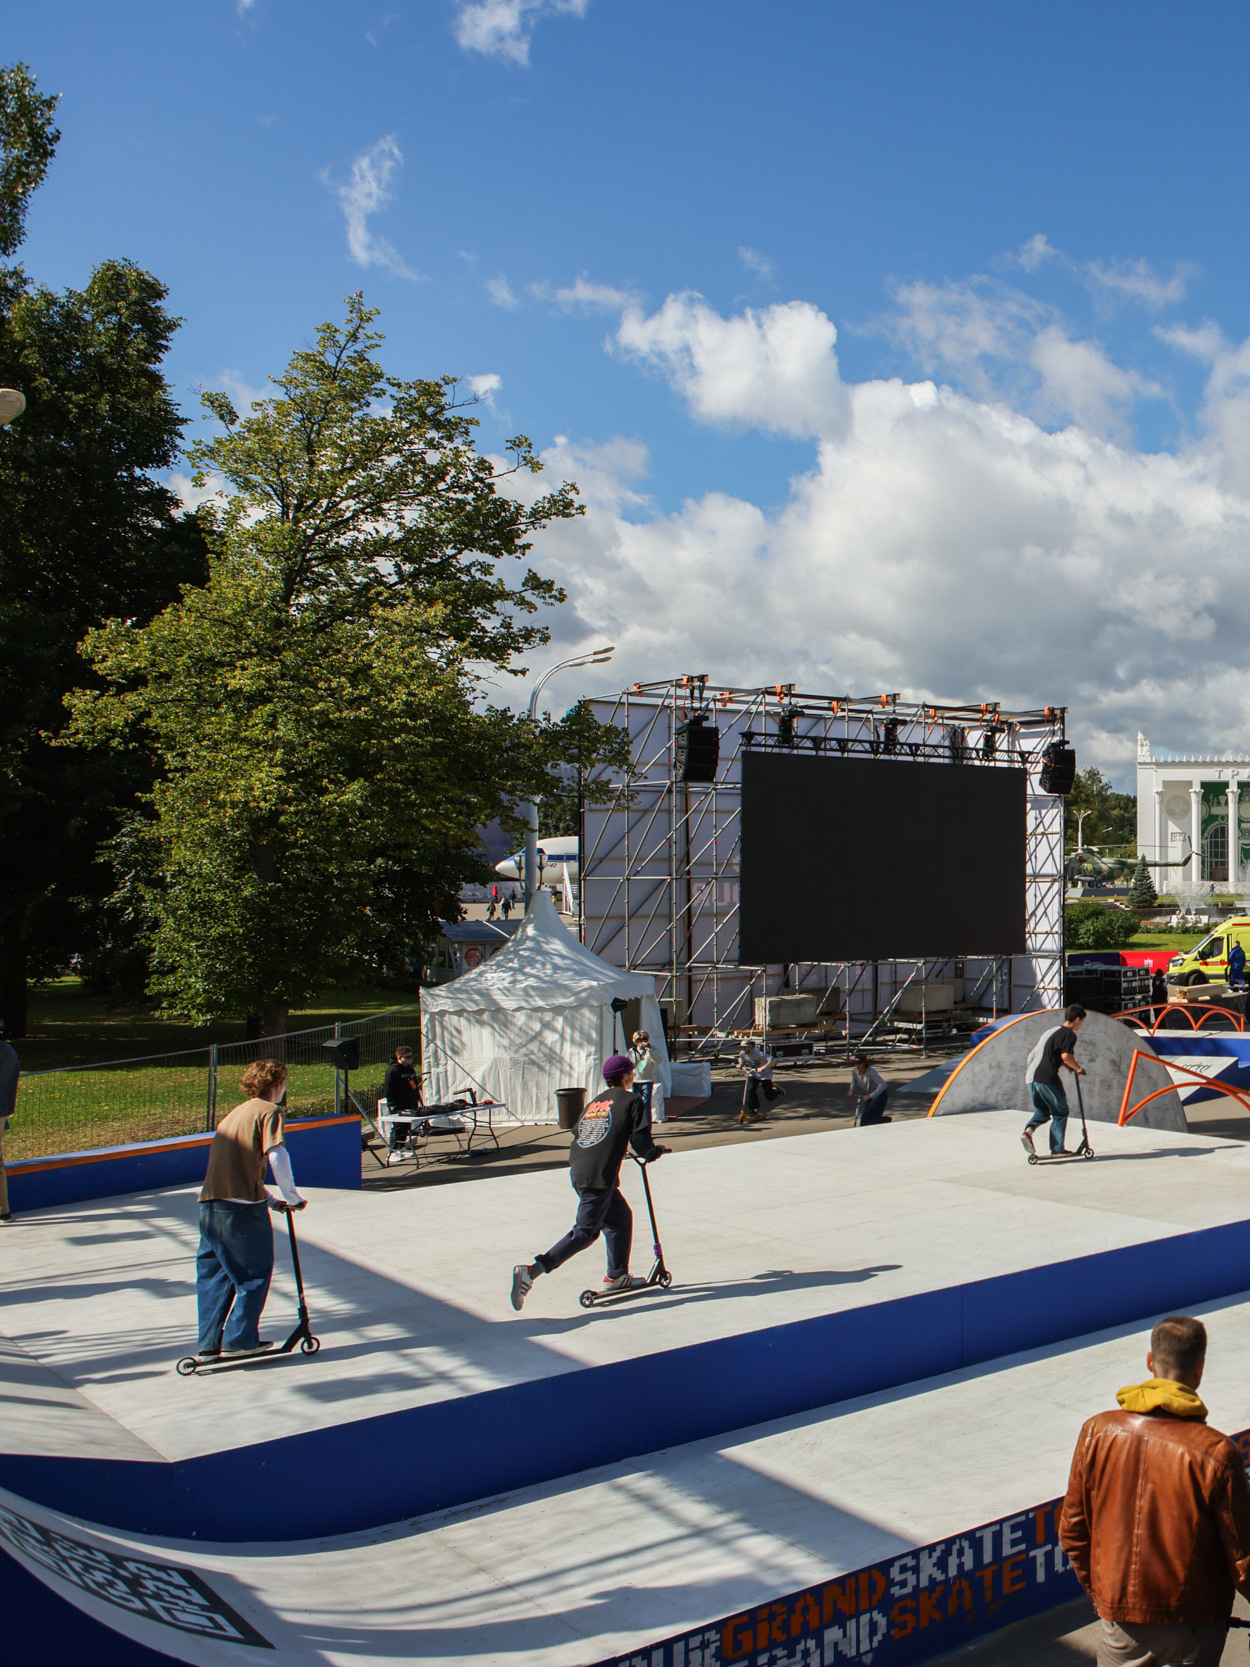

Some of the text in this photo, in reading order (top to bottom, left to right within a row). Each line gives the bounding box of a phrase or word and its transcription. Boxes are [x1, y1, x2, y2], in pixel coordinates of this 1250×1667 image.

[1083, 863, 1093, 871] 70
[722, 1568, 886, 1661] GRAND
[890, 1515, 1026, 1598] SKATE
[890, 1554, 1027, 1640] SKATE
